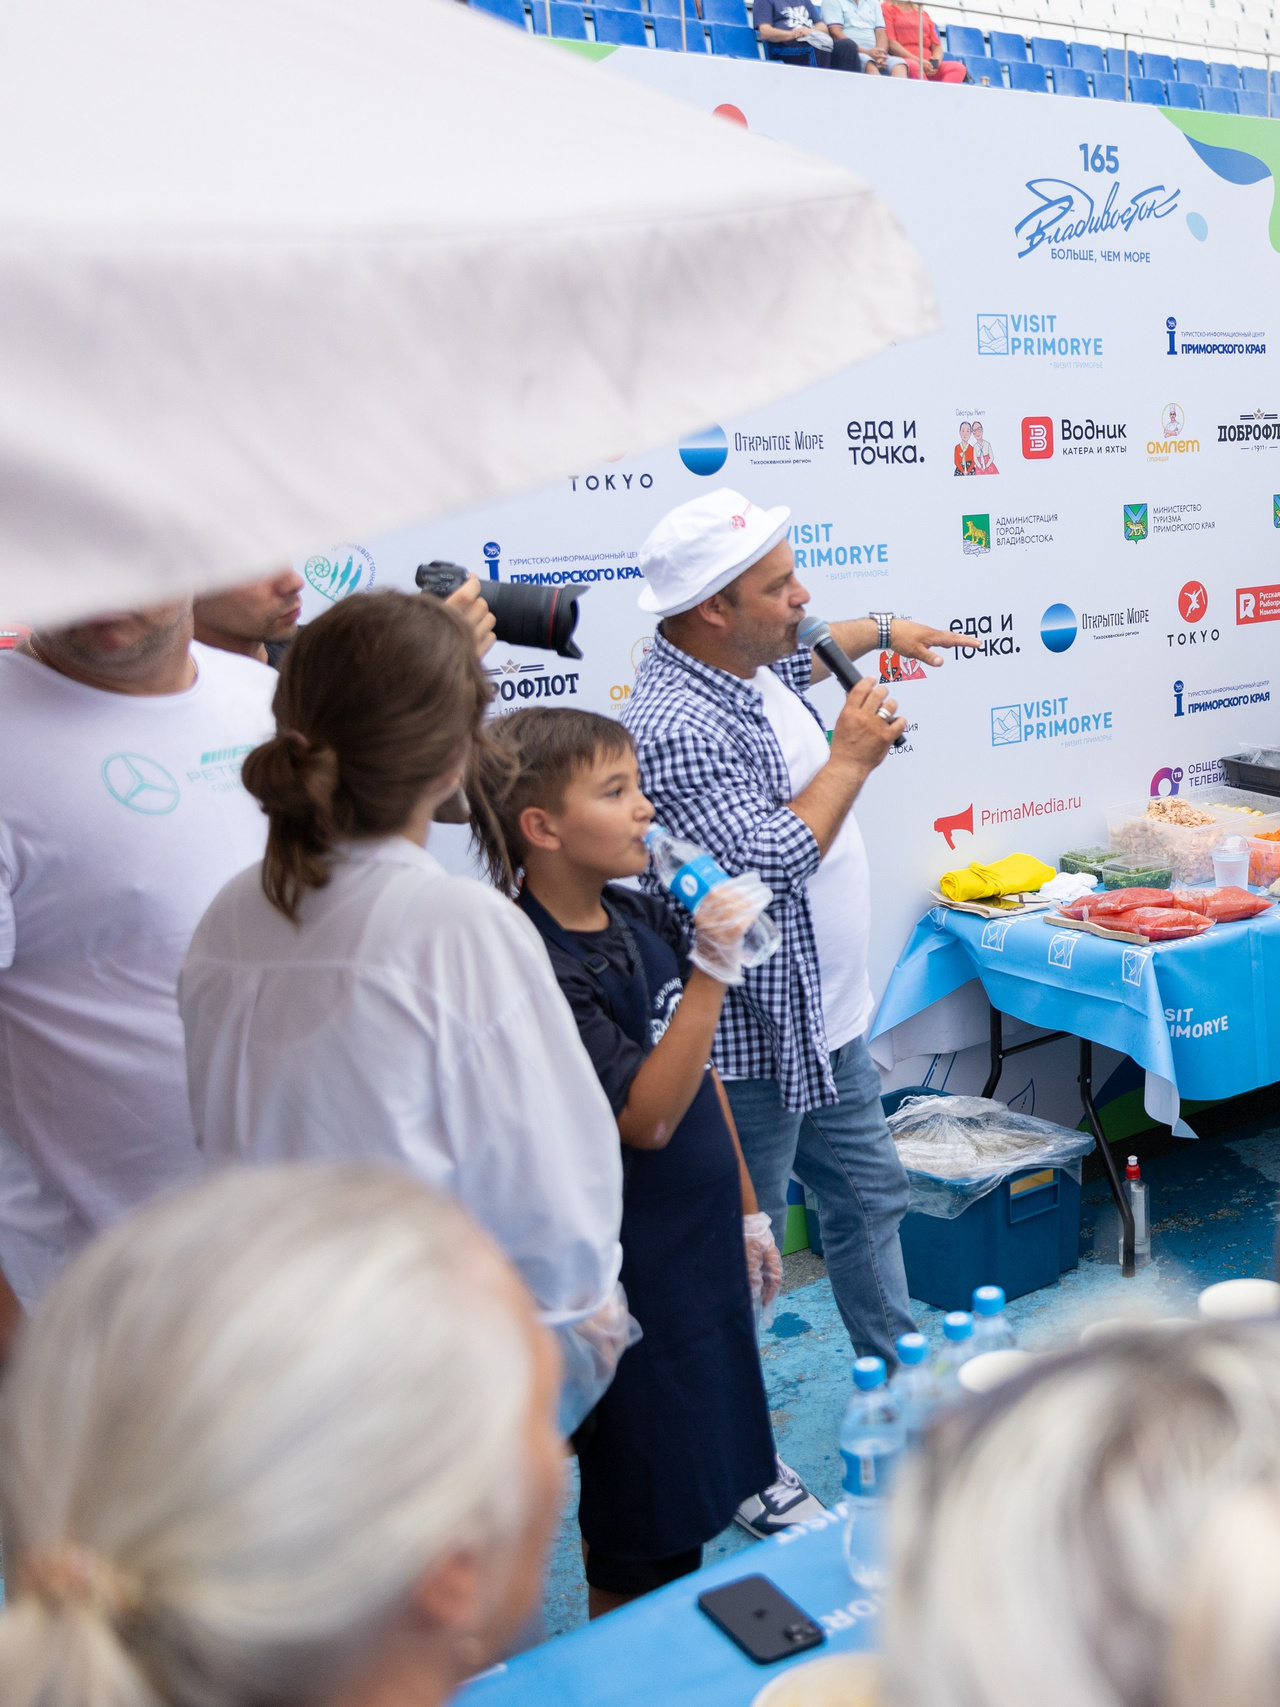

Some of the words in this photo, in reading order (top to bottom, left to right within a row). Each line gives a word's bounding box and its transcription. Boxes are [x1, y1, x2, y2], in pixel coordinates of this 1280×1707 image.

[1079, 143, 1119, 174] 165
[1051, 249, 1097, 263] БОЛЬШЕ,
[1100, 251, 1121, 262] ЧЕМ
[1124, 252, 1151, 263] МОРЕ
[1011, 314, 1057, 333] VISIT
[1011, 337, 1103, 356] PRIMORYE
[1181, 343, 1244, 355] ПРИМОРСКОГО
[1245, 344, 1266, 355] КРАЯ
[847, 420, 894, 443] еда
[903, 420, 917, 439] и
[1061, 418, 1127, 441] Водник
[848, 444, 926, 465] точка.
[1062, 447, 1095, 455] КАТЕРА
[1105, 445, 1127, 454] ЯХТЫ
[568, 473, 653, 491] TOKYO
[1153, 504, 1202, 514] МИНИСТЕРСТВО
[1153, 514, 1181, 523] ТУРИЗМА
[996, 514, 1058, 526] АДМИНИСТРАЦИЯ
[1153, 523, 1200, 534] ПРИМОРСКОГО
[1201, 521, 1216, 531] КРАЯ
[996, 526, 1025, 536] ГОРОДА
[996, 534, 1054, 546] ВЛАДИВОСТОКА
[508, 551, 626, 566] ТУРИСТСКО-ИНФОРМАЦИОННЫЙ
[795, 544, 888, 568] RIMORYE
[617, 566, 645, 580] КРА
[949, 615, 992, 638] еда
[1001, 614, 1013, 631] и
[1167, 628, 1220, 647] TOKYO
[1023, 697, 1068, 720] VISIT
[1188, 695, 1249, 714] ПРИМОРСКОГО
[1250, 691, 1270, 704] КРАЯ
[1023, 711, 1113, 742] PRIMORYE
[981, 796, 1082, 827] PrimaMedia.ru
[1164, 1008, 1194, 1022] SIT
[1170, 1015, 1229, 1038] IMORYE
